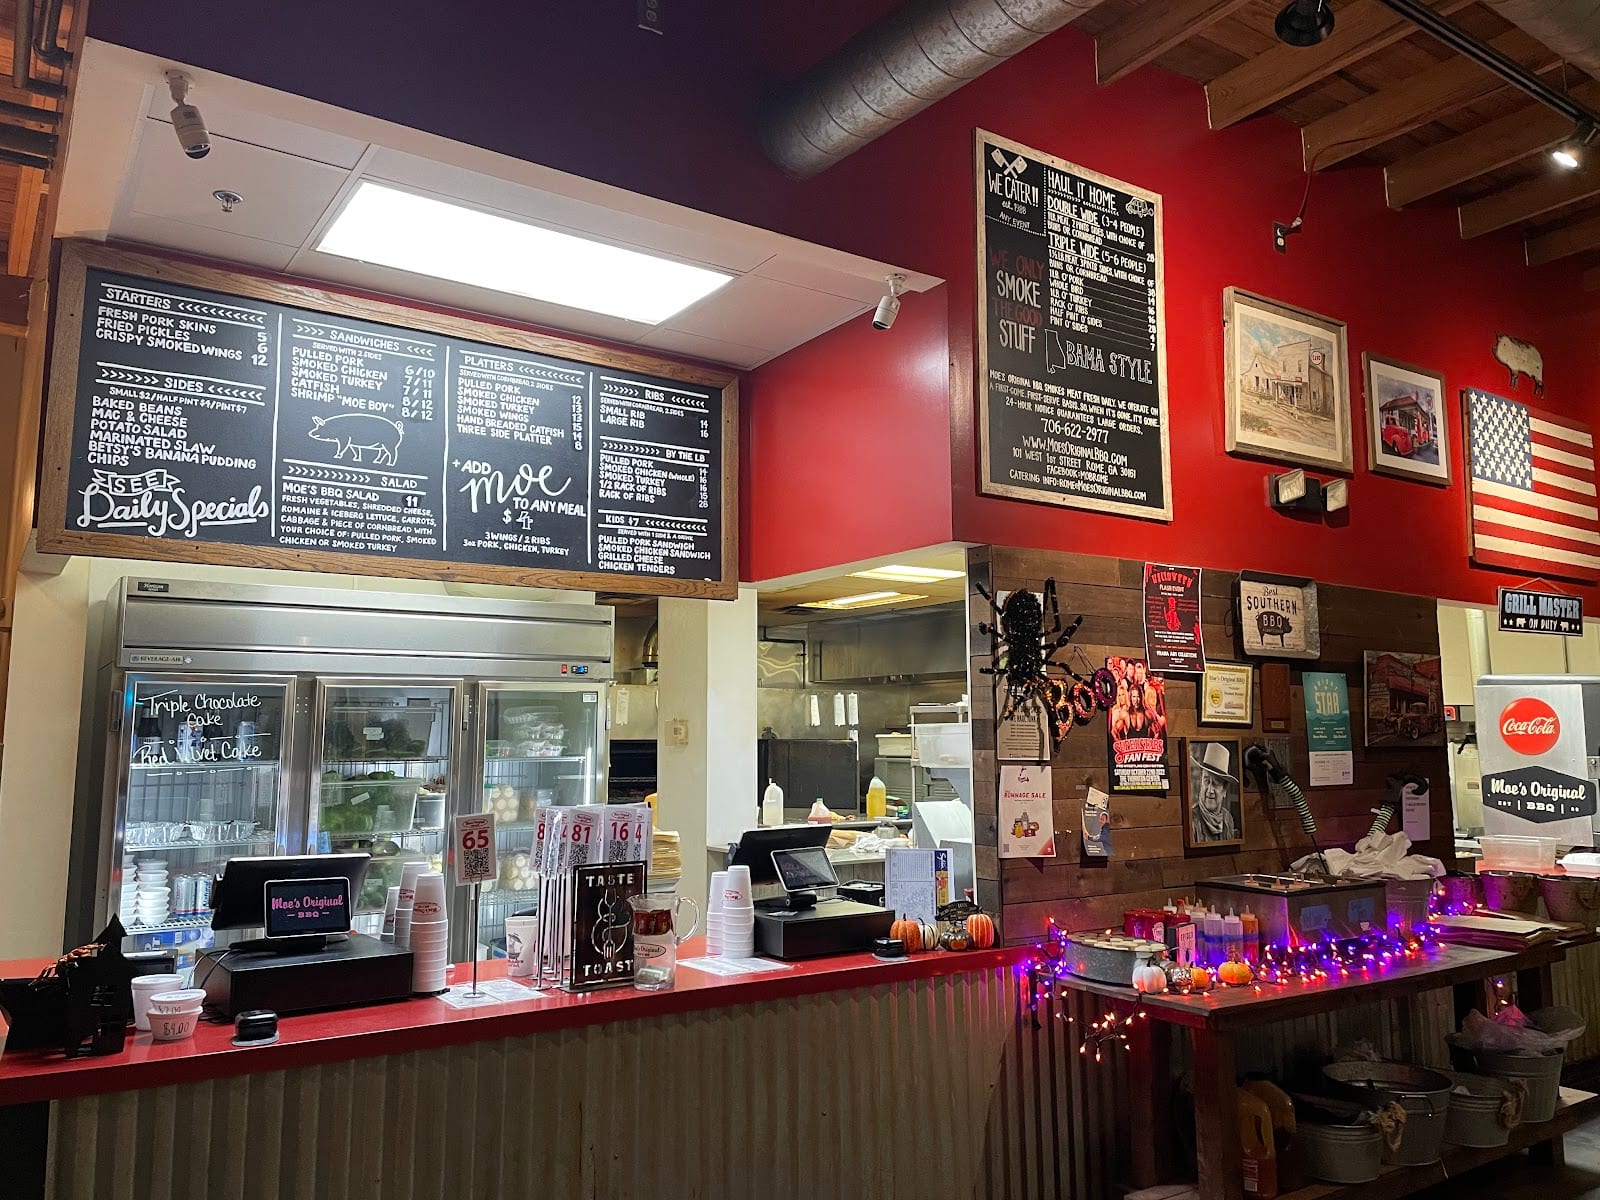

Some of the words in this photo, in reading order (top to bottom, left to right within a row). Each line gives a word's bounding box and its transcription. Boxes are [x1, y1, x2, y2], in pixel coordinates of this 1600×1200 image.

[988, 169, 1003, 195] WE
[1005, 177, 1038, 207] CATER!!
[1048, 170, 1073, 195] HAUL
[1077, 182, 1085, 199] IT
[1089, 185, 1116, 211] HOME
[1048, 195, 1078, 217] DOUBLE
[1080, 207, 1098, 224] WIDE
[1102, 215, 1118, 230] (3-4
[1120, 221, 1144, 238] PEOPLE)
[1048, 232, 1076, 253] TRIPLE
[1080, 242, 1099, 261] WIDE
[1102, 251, 1119, 265] (5-6
[1121, 256, 1146, 274] PEOPLE)
[106, 288, 171, 310] STARTERS
[996, 270, 1041, 308] SMOKE
[1049, 278, 1068, 291] WHOLE
[1148, 307, 1155, 315] 16
[1075, 304, 1088, 315] RIBS
[99, 306, 137, 321] FRESH
[142, 314, 174, 328] PORK
[179, 320, 216, 334] SKINS
[257, 332, 268, 342] 5
[97, 317, 134, 332] FRIED
[138, 325, 190, 341] PICKLES
[257, 343, 268, 353] 6
[330, 330, 399, 351] SANDWICHES
[1000, 319, 1036, 353] STUFF
[96, 329, 143, 345] CRISPY
[147, 337, 200, 354] SMOKED
[200, 345, 242, 360] WINGS
[251, 354, 268, 366] 12
[293, 347, 332, 362] PULLED
[335, 353, 364, 367] PORK
[292, 357, 338, 373] SMOKED
[341, 365, 387, 381] CHICKEN
[465, 356, 514, 372] PLATTERS
[1066, 340, 1105, 372] BAMA
[1109, 352, 1152, 384] STYLE
[164, 377, 204, 392] SIDES
[291, 377, 339, 394] CATFISH
[292, 367, 338, 382] SMOKED
[341, 375, 383, 391] TURKEY
[291, 387, 335, 403] SHRIMP
[458, 377, 492, 389] PULLED
[495, 384, 521, 394] PORK
[572, 396, 581, 404] 12
[458, 387, 497, 399] SMOKED
[500, 393, 539, 406] CHICKEN
[572, 405, 582, 413] 13
[645, 390, 664, 401] RIBS
[93, 396, 134, 411] BAKED
[139, 402, 182, 416] BEANS
[92, 408, 120, 420] MAC
[126, 411, 135, 422] &
[139, 413, 188, 428] CHEESE
[600, 405, 628, 417] SMALL
[630, 410, 645, 419] RIB
[700, 420, 708, 429] 14
[600, 414, 628, 426] LARGE
[630, 419, 644, 428] RIB
[700, 430, 708, 438] 16
[91, 419, 140, 434] POTATO
[144, 424, 187, 439] SALAD
[457, 424, 486, 435] THREE
[491, 428, 510, 438] SIDE
[514, 431, 552, 445] PLATTER
[1041, 418, 1108, 444] 706-622-2977
[90, 430, 171, 449] MARINATED
[174, 440, 215, 455] SLAW
[88, 452, 129, 466] CHIPS
[89, 440, 141, 456] BETSY'S
[145, 447, 199, 463] BANANA
[202, 455, 256, 470] PUDDING
[666, 449, 676, 458] BY
[678, 451, 693, 460] THE
[695, 454, 705, 462] LB
[1012, 447, 1021, 458] 101
[1025, 451, 1042, 463] WEST
[1059, 456, 1081, 468] STREET
[1108, 465, 1118, 476] GA
[461, 460, 492, 474] ADD
[1009, 469, 1040, 483] CATERING
[114, 472, 159, 493] SEE
[381, 477, 417, 488] SALAD
[282, 495, 308, 504] FRESH
[362, 503, 401, 513] SHREDDED
[283, 483, 317, 495] MOE'S
[321, 487, 343, 499] BBQ
[346, 490, 379, 501] SALAD
[406, 496, 418, 507] 11
[77, 483, 169, 537] Daily
[168, 485, 269, 537] Specials
[513, 497, 529, 509] TO
[530, 500, 556, 512] ANY
[558, 502, 586, 516] MEAL
[606, 515, 624, 524] KIDS
[598, 552, 632, 562] GRILLED
[634, 555, 663, 564] CHEESE
[599, 561, 634, 571] CHICKEN
[637, 564, 675, 574] TENDERS
[1264, 586, 1277, 596] Best
[1247, 596, 1297, 615] SOUTHERN
[1505, 593, 1536, 616] GRILL
[1539, 596, 1579, 619] MASTER
[1263, 615, 1282, 627] BBQ
[1529, 619, 1538, 628] ON
[1541, 620, 1558, 631] DUTY
[139, 690, 190, 716] Triple
[195, 693, 261, 711] Chocolate
[187, 713, 223, 727] Cake
[1503, 717, 1555, 735] Coca-Cola
[175, 742, 217, 762] Vlvet
[221, 741, 262, 758] Cake
[1124, 753, 1141, 763] FAN
[1142, 753, 1162, 761] FEST
[1491, 778, 1527, 796] Moe's
[1530, 781, 1586, 801] Original
[1526, 802, 1555, 812] BBQ
[462, 830, 489, 849] 65
[572, 824, 591, 844] 81
[612, 822, 628, 841] 16
[586, 873, 633, 887] TASTE
[272, 897, 300, 910] Moe's
[303, 894, 343, 909] Original
